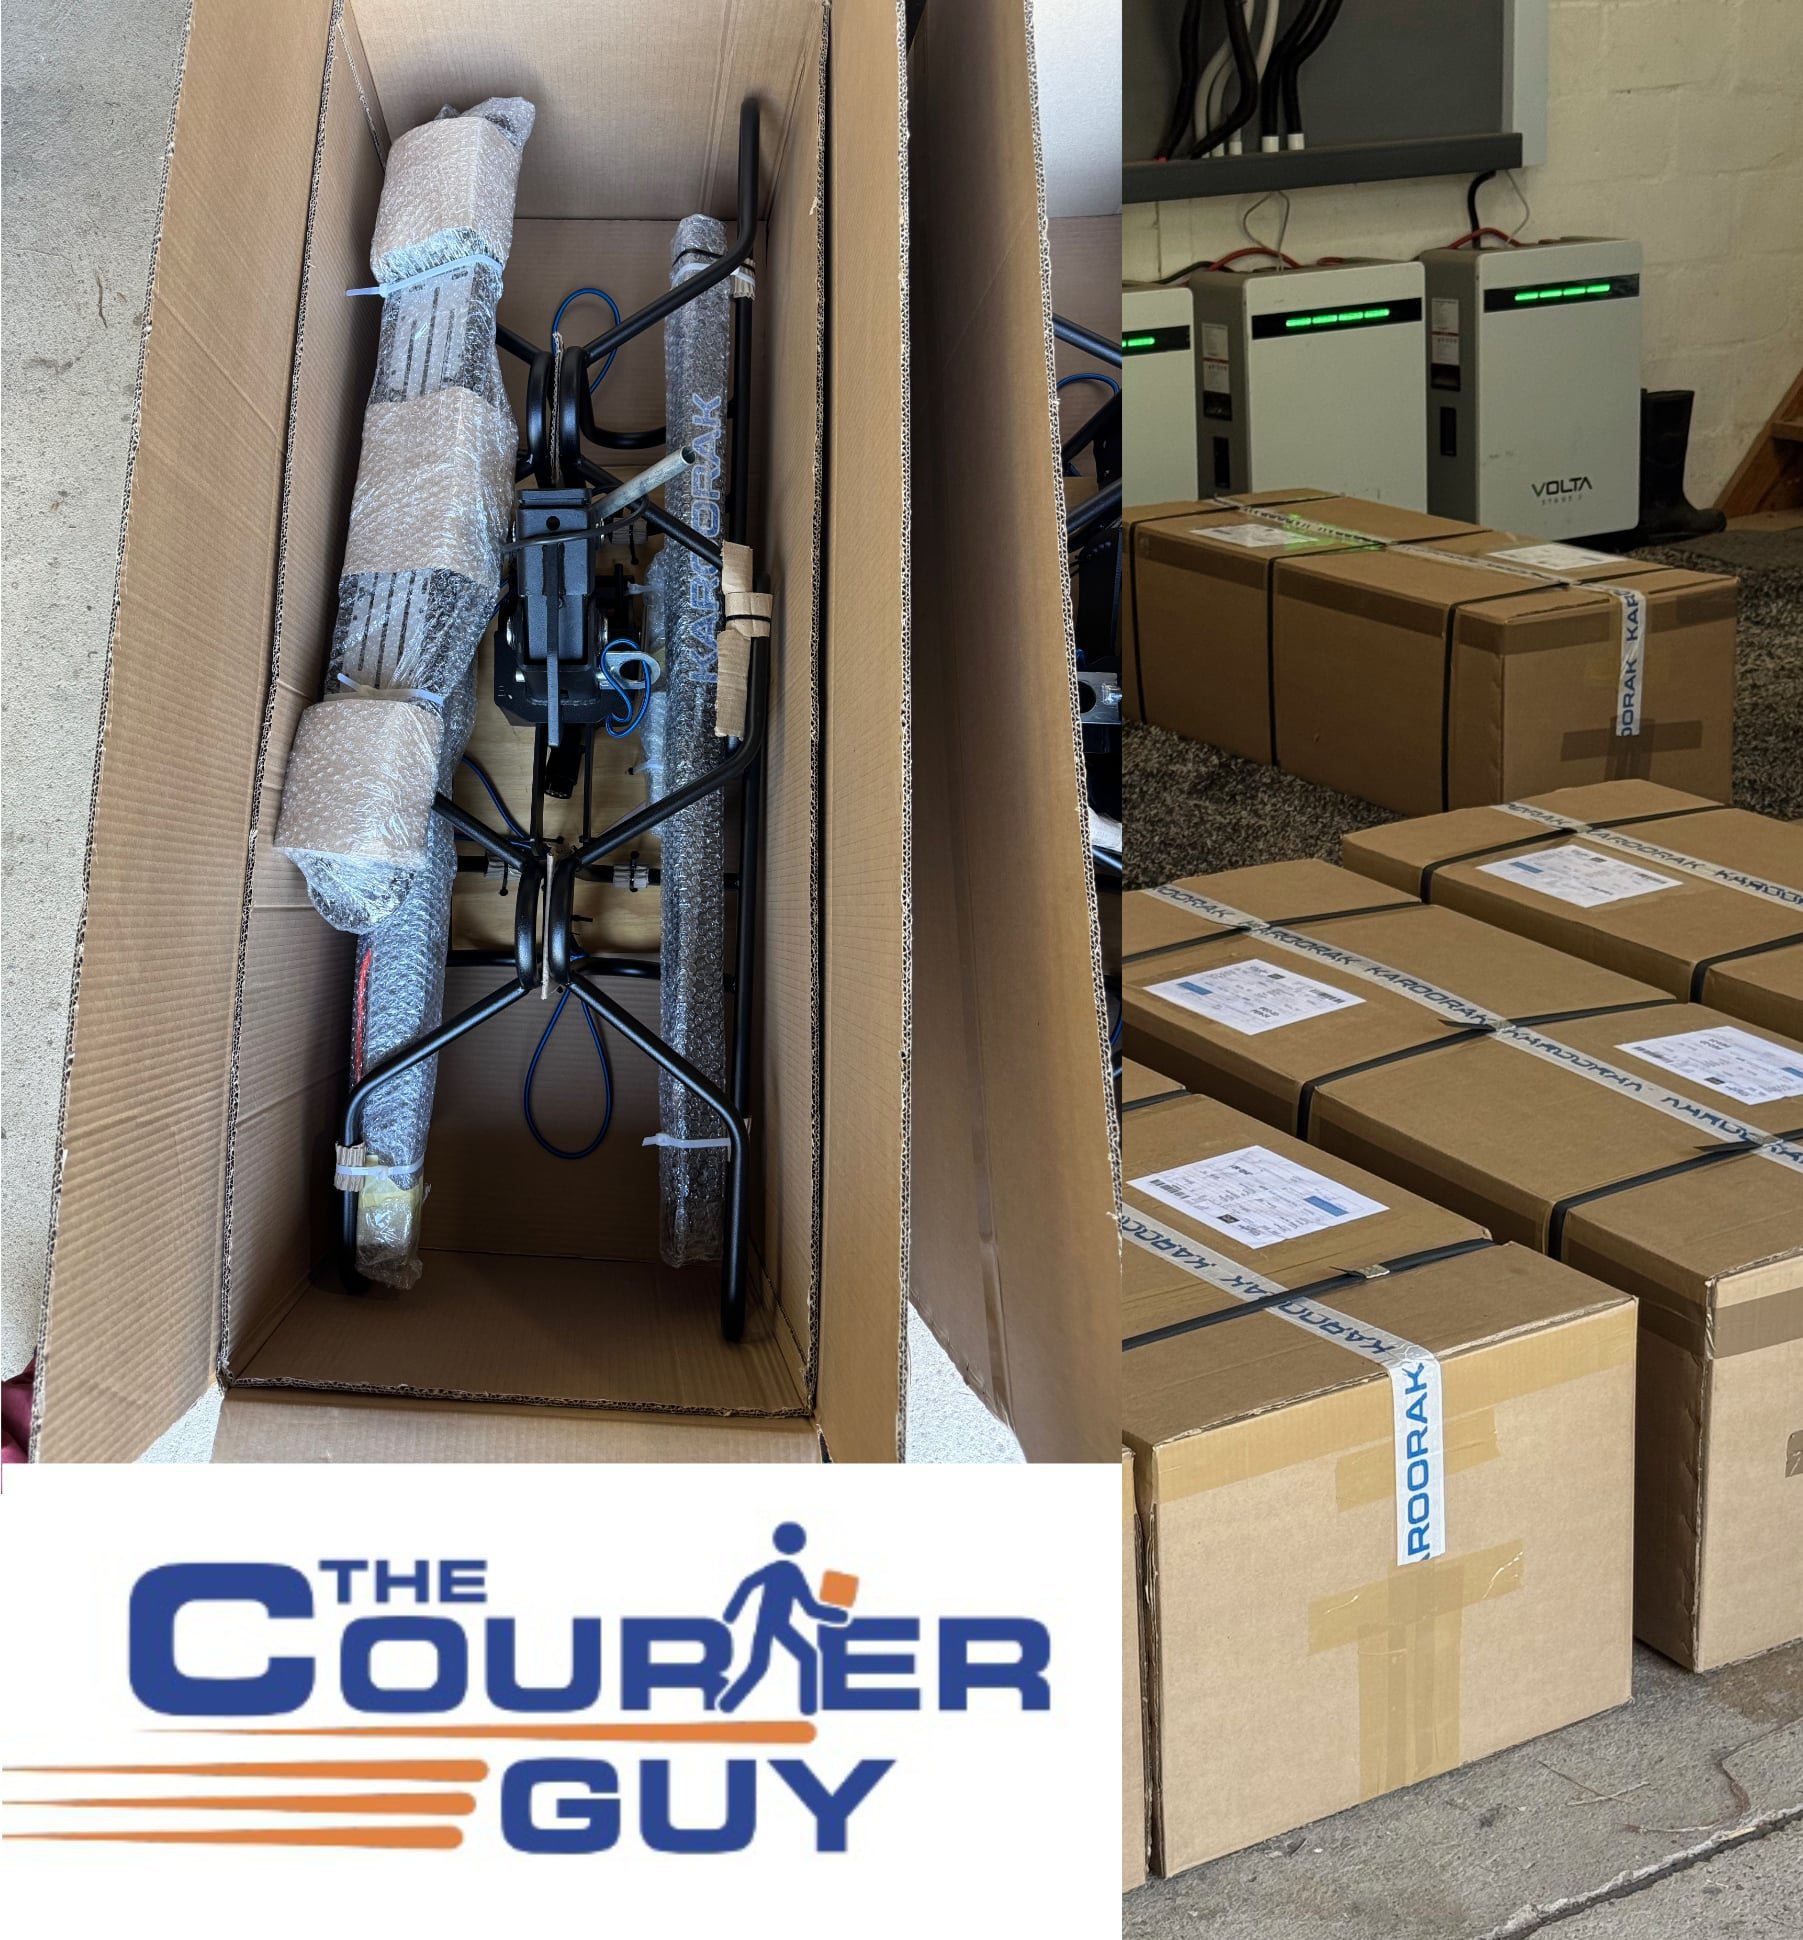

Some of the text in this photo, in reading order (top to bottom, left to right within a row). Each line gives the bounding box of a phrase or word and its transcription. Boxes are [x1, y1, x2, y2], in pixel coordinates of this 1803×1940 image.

[1531, 476, 1593, 497] VOLTA
[1714, 869, 1803, 905] KAROO
[1121, 1215, 1396, 1355] KAROOAK KAROO
[1404, 1362, 1431, 1561] ROORAK
